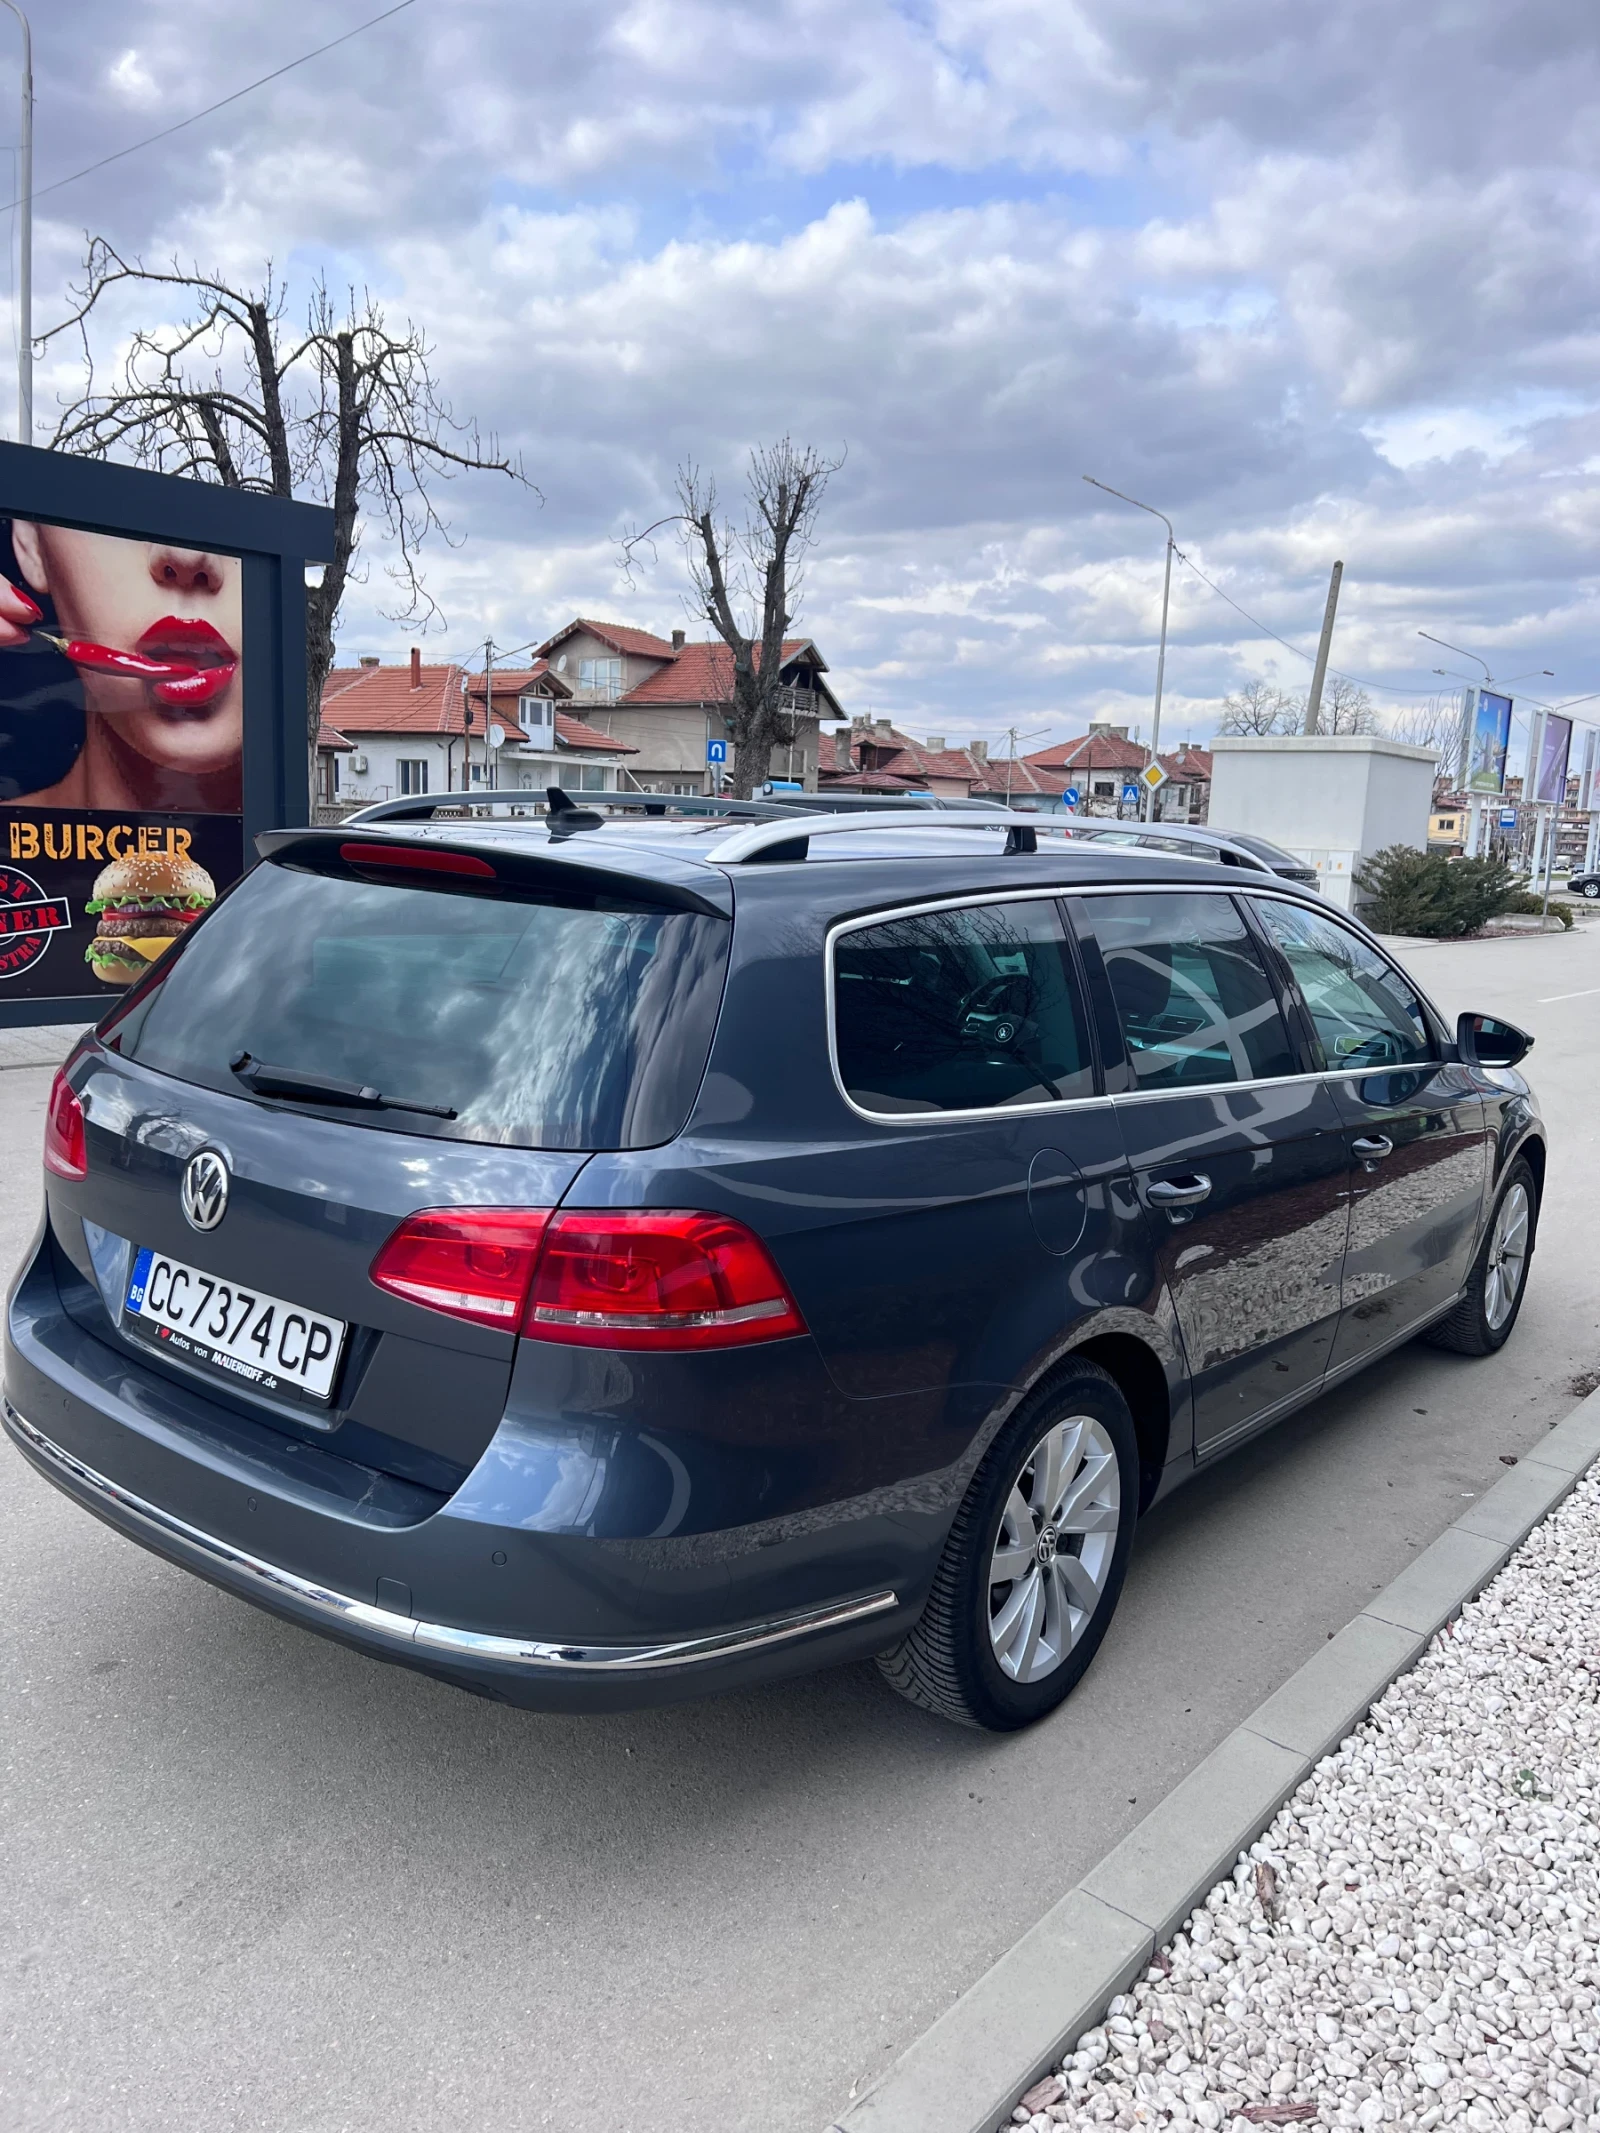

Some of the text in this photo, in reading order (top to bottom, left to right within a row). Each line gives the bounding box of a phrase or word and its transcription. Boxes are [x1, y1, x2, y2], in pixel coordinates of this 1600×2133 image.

[9, 822, 193, 861] BURGER
[130, 1284, 144, 1303] BG
[169, 1333, 191, 1350] Autos
[194, 1345, 208, 1359] von
